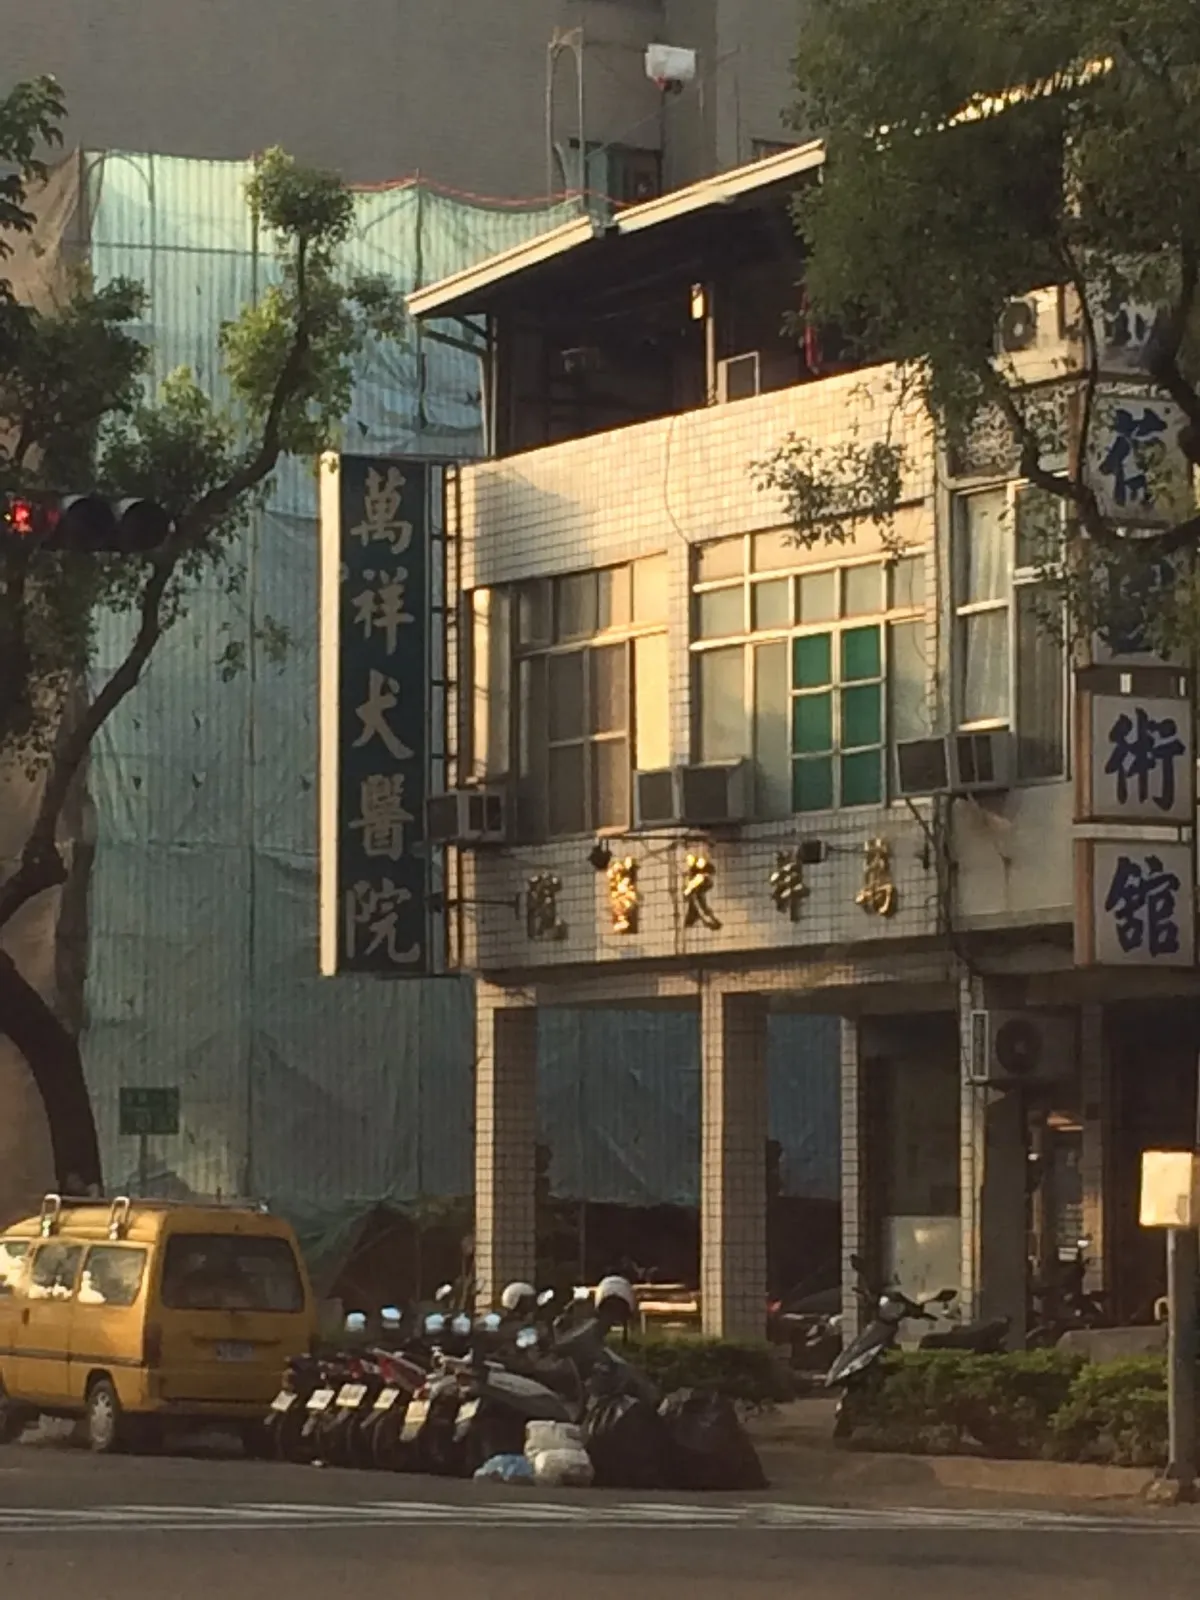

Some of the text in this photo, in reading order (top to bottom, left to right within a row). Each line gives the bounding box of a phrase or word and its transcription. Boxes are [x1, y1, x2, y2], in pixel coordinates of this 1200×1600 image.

[345, 466, 421, 965] 萬祥犬醫院
